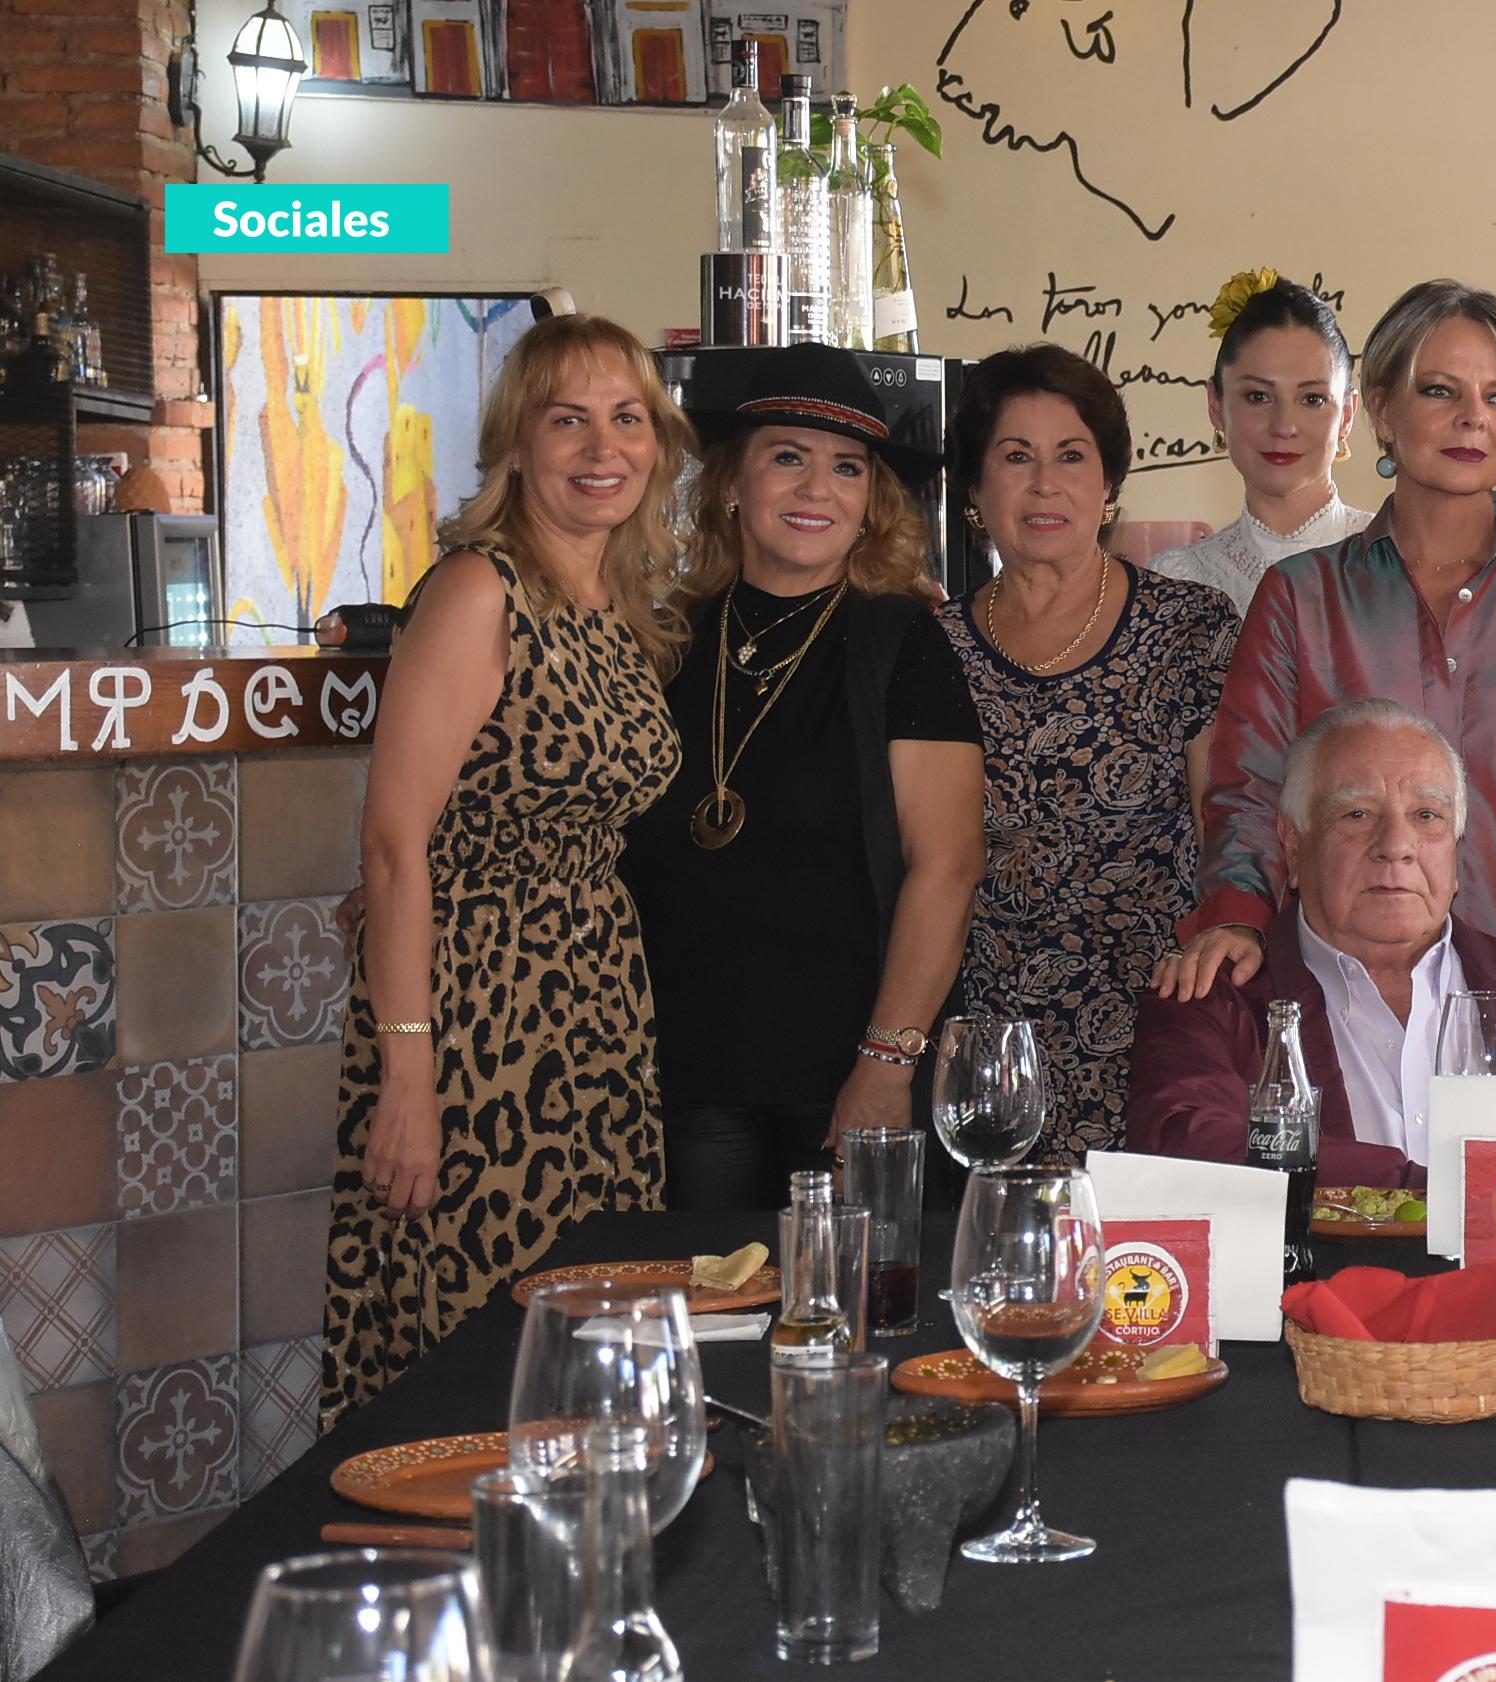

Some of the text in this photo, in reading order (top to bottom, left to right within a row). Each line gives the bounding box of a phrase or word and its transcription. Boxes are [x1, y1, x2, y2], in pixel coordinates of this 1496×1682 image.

[1042, 272, 1122, 333] toros
[1261, 1152, 1283, 1161] ZERO
[1105, 1255, 1154, 1279] STAURANT
[1116, 1326, 1160, 1337] CORTIJO
